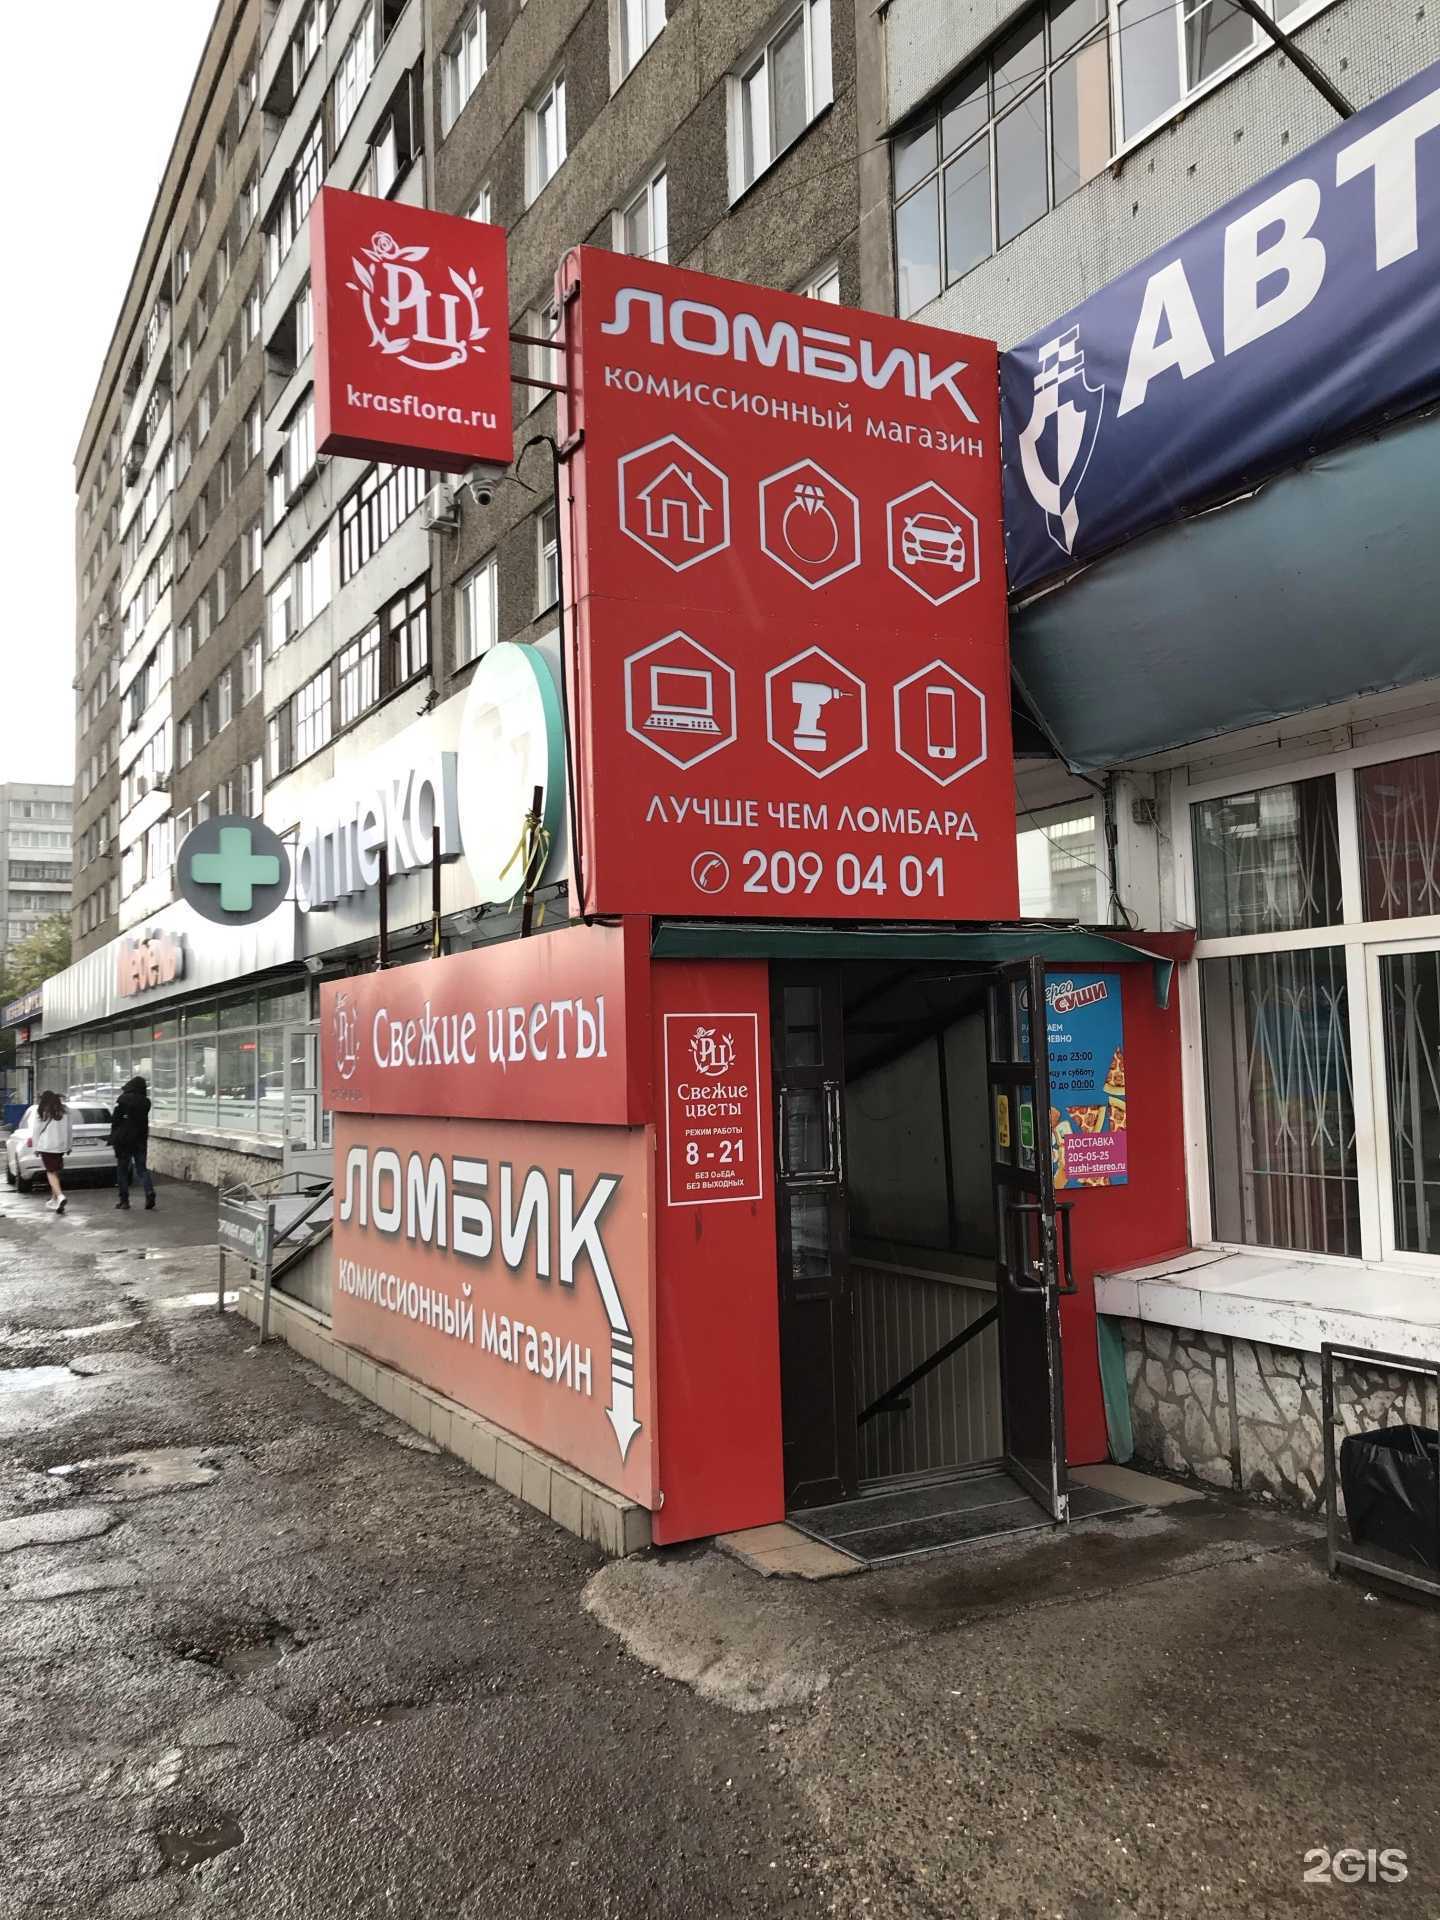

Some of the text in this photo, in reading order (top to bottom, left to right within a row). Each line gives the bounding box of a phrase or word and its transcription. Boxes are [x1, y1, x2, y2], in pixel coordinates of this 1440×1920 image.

[1117, 88, 1440, 418] АВТ
[601, 288, 979, 423] ЛОМБИК
[347, 384, 497, 429] krasflora.ru
[604, 366, 984, 458] комиссионный магазин
[645, 795, 978, 841] ЛУЧШЕ ЧЕМ ЛОМБАРД
[743, 850, 944, 897] 209 04 01
[373, 995, 607, 1075] Свежие цветы
[677, 1083, 748, 1119] Свежие цветы
[685, 1127, 743, 1136] РЕЖИМ РАБОТЫ
[686, 1142, 699, 1165] 8
[719, 1139, 744, 1163] 21
[1068, 1137, 1115, 1150] ДОСТАВКА
[1068, 1151, 1110, 1162] 205-05-25
[1068, 1163, 1126, 1173] sushi-stereo.ru
[686, 1179, 744, 1190] БЕЗ ВЫХОДНЫХ
[339, 1145, 629, 1332] ЛОМБИК
[339, 1257, 592, 1396] комиссионный магазин
